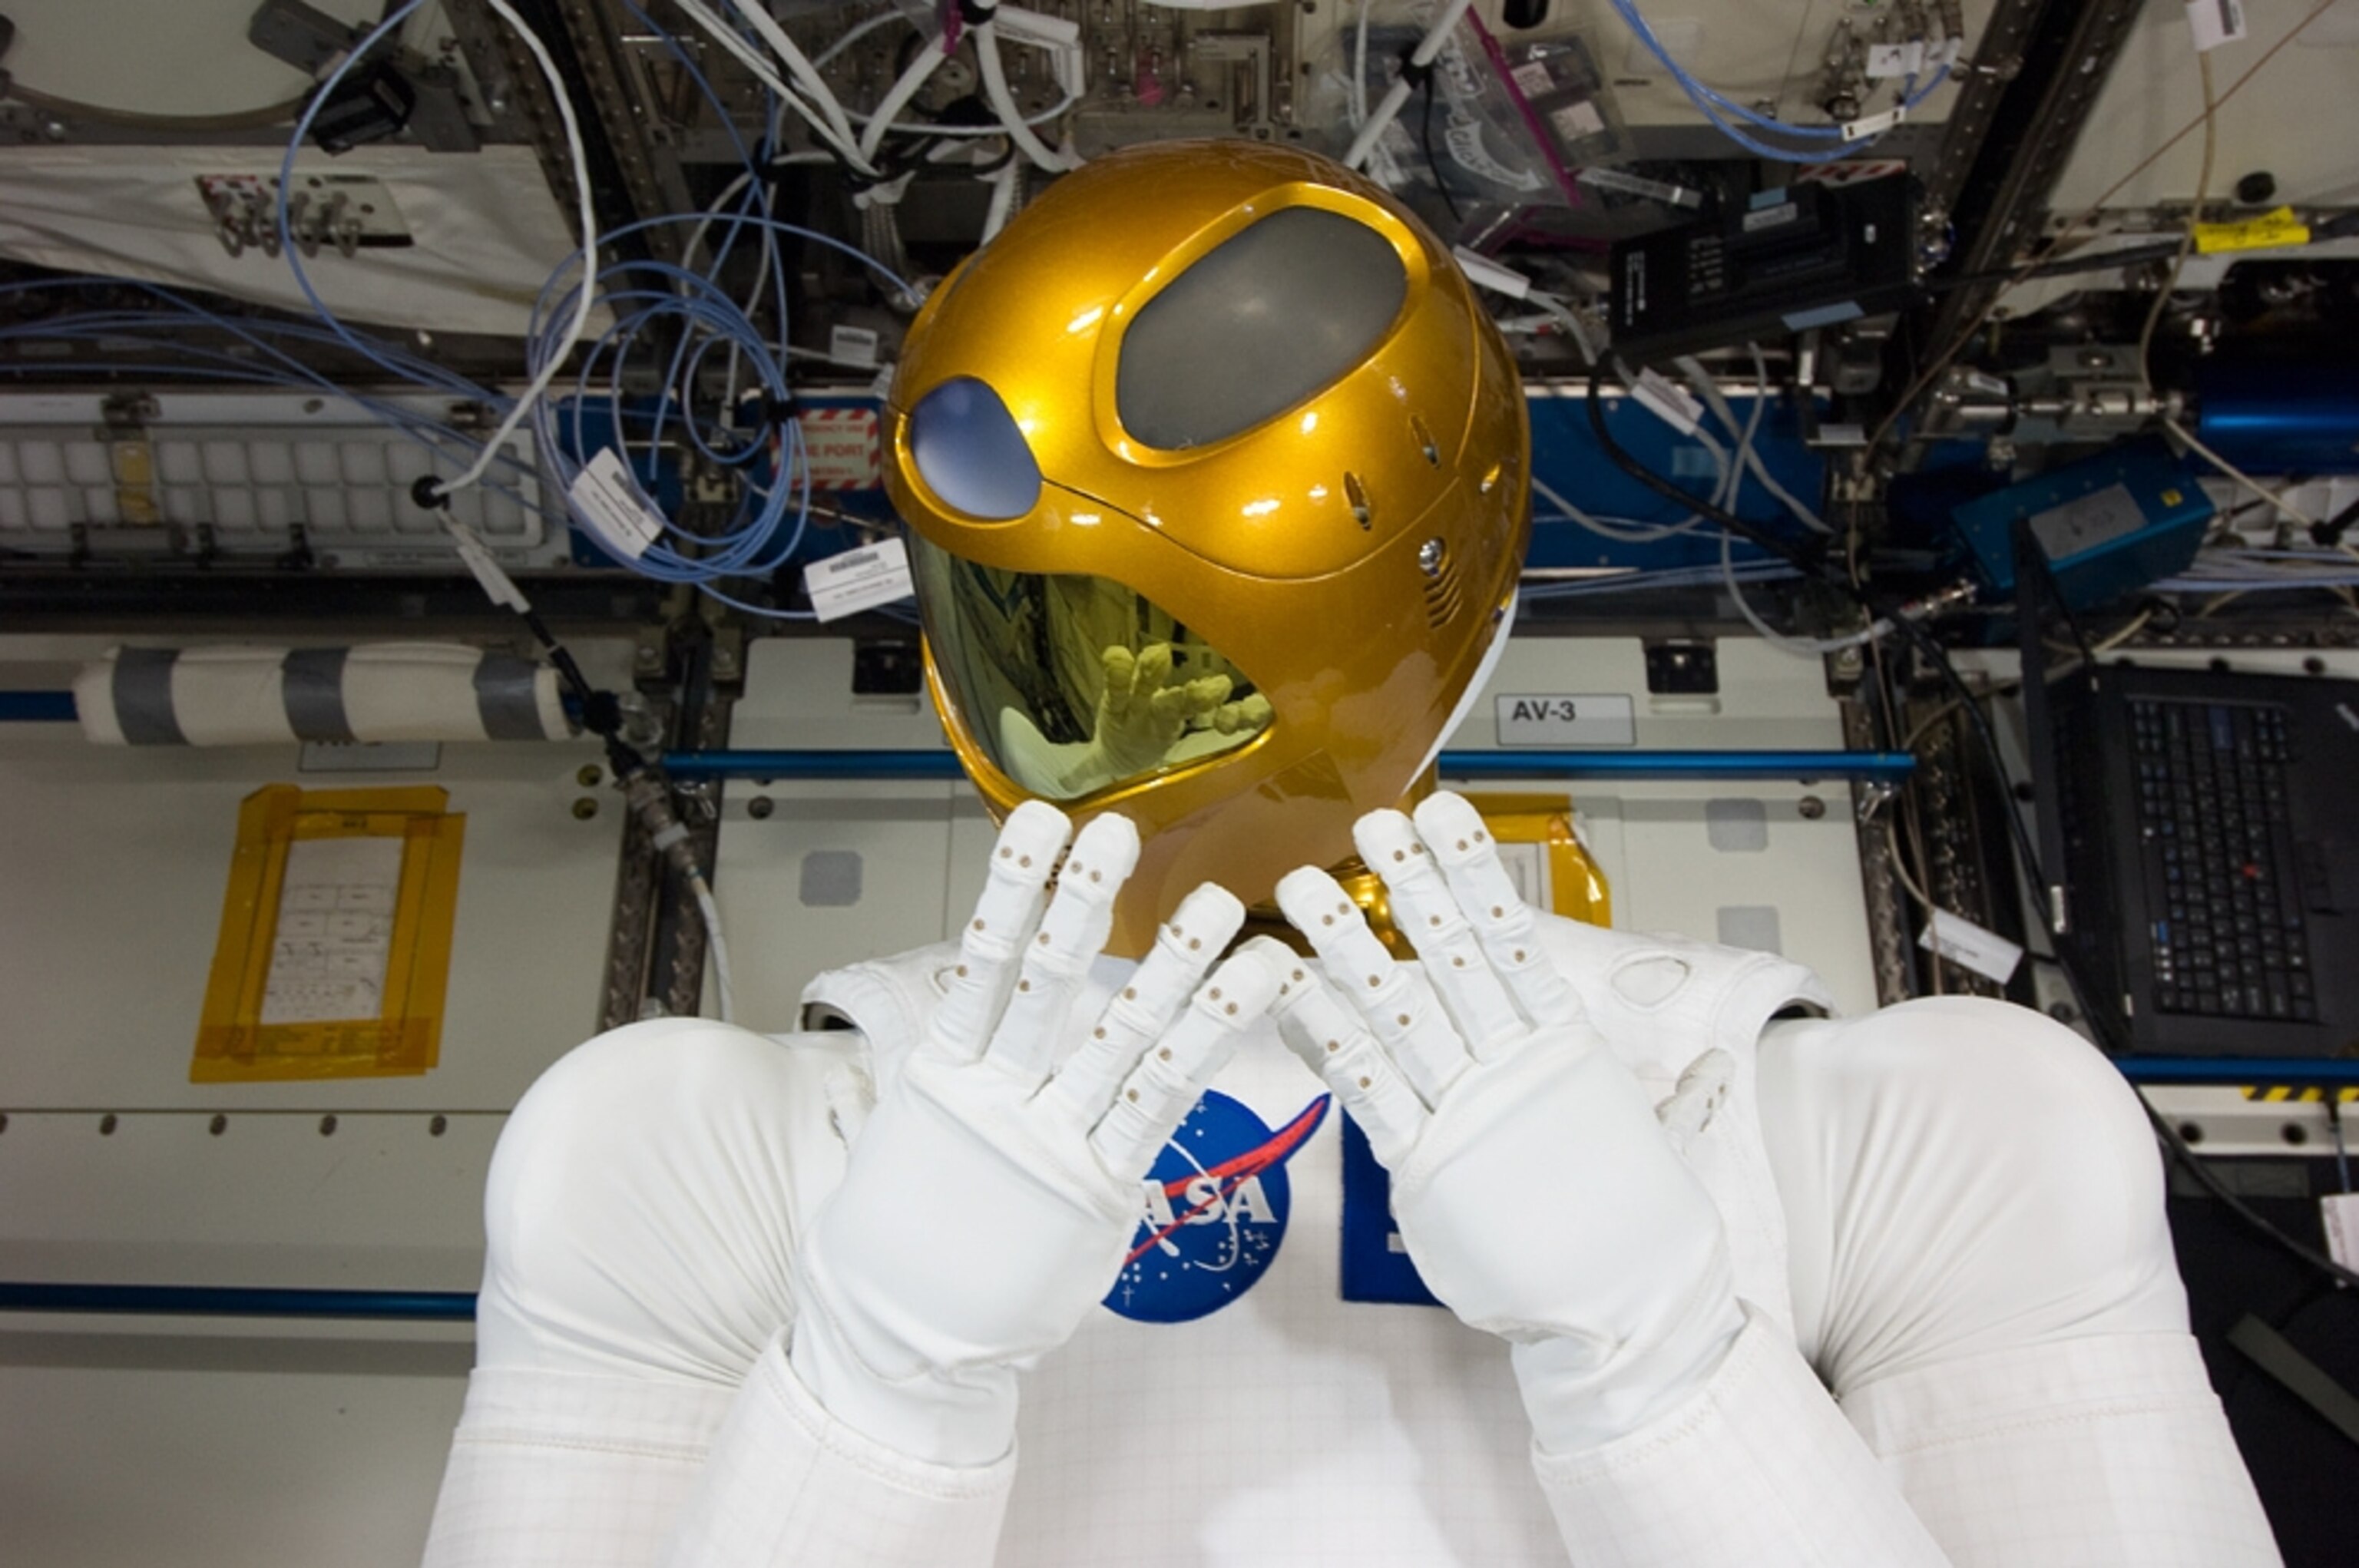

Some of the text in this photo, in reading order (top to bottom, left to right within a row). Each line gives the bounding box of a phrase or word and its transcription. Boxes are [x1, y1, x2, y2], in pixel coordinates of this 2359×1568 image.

[824, 443, 864, 457] PORT
[1511, 700, 1576, 722] AV-3
[1140, 1174, 1278, 1226] ASA
